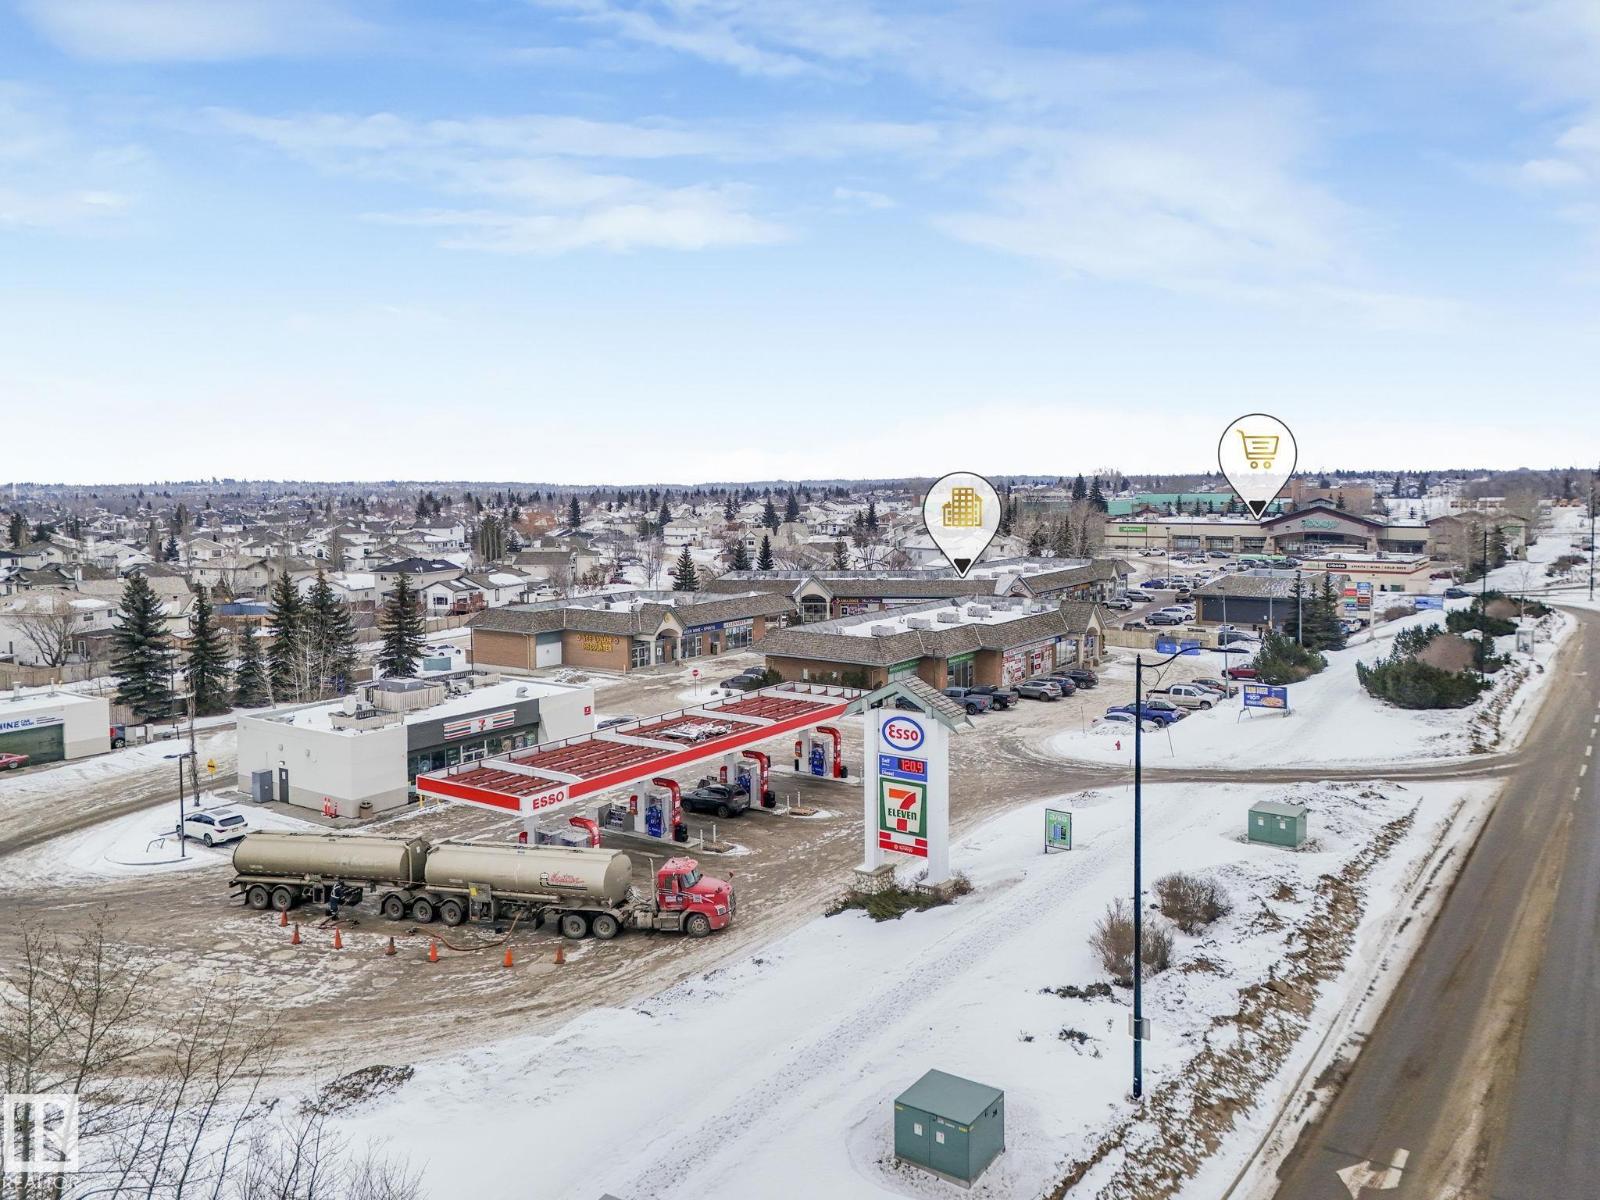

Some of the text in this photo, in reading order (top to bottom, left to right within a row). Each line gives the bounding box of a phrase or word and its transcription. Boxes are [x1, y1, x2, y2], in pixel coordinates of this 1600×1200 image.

[902, 759, 924, 774] 120.9
[532, 791, 564, 810] ESSO
[888, 788, 917, 832] 7
